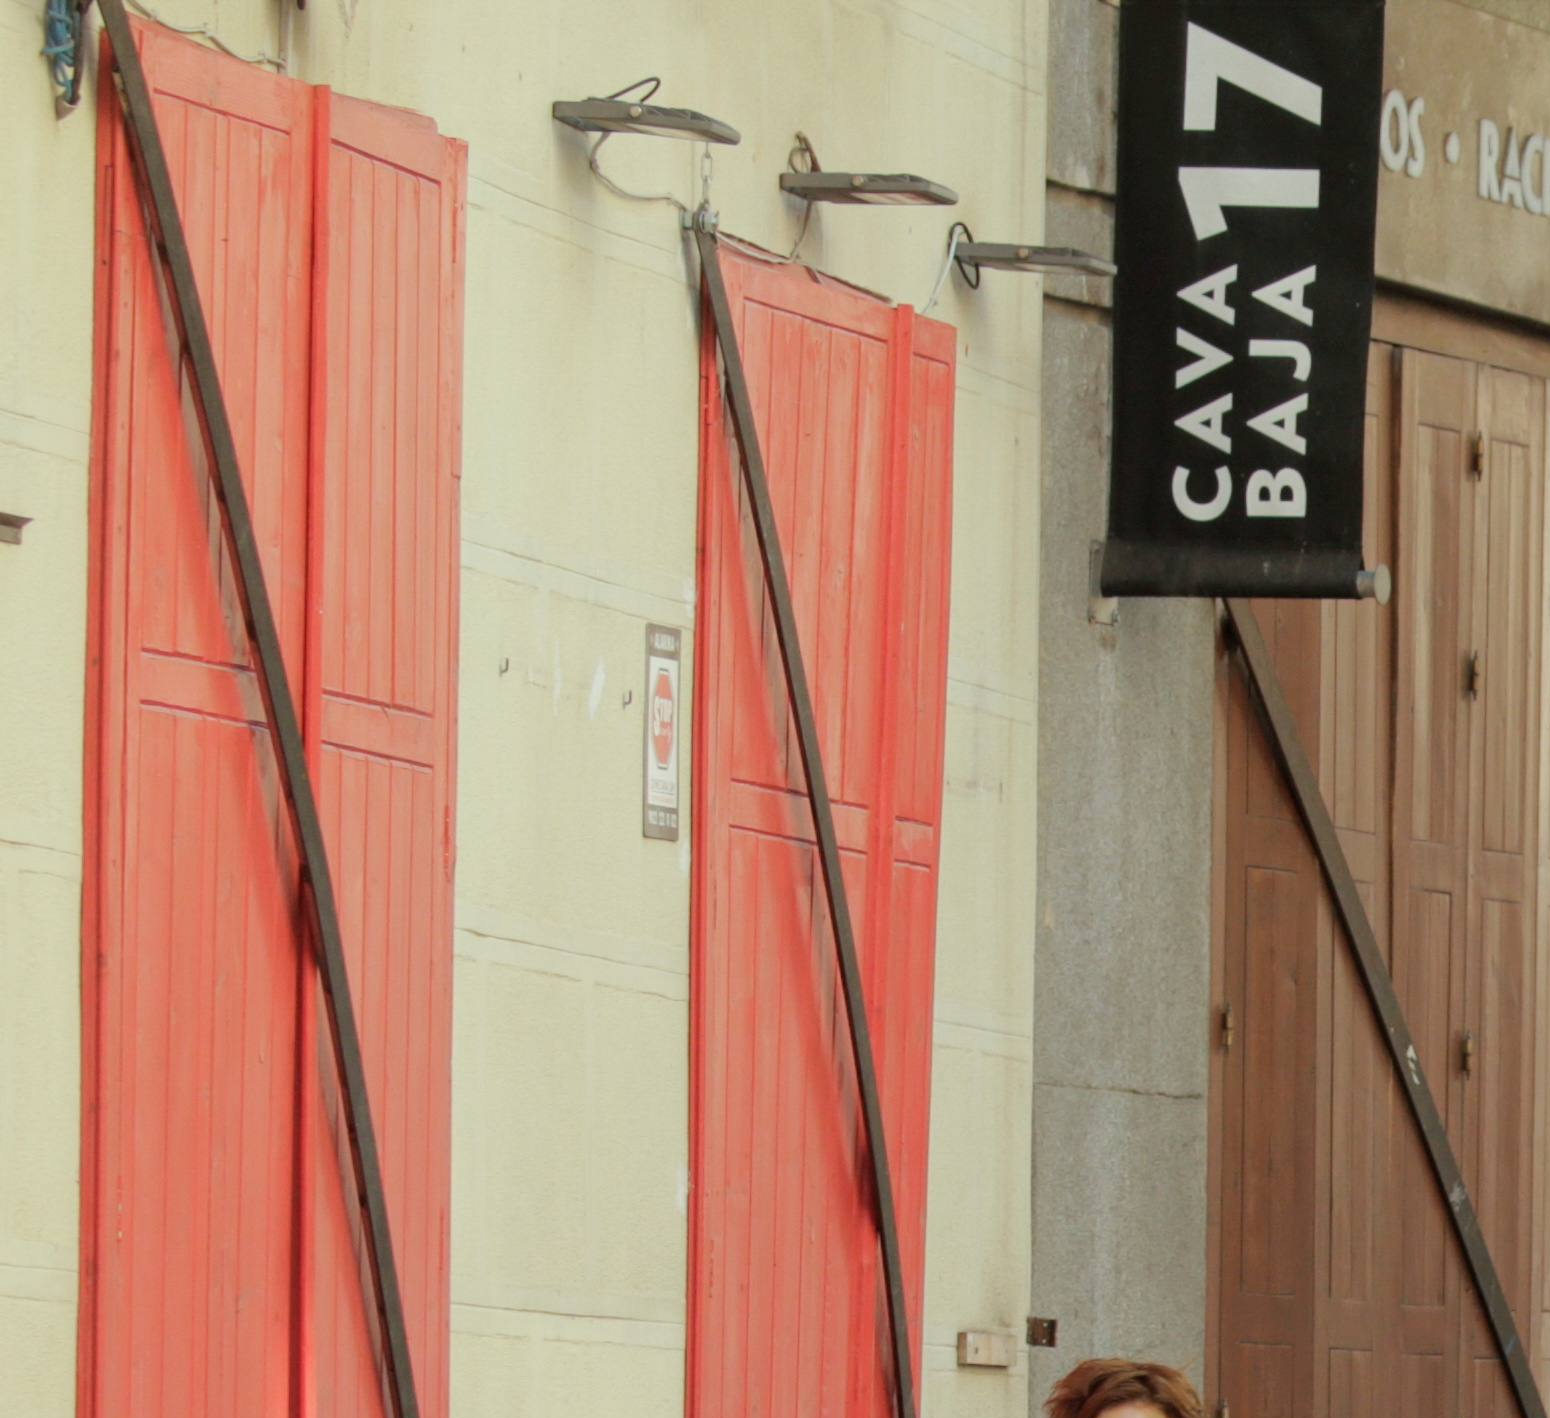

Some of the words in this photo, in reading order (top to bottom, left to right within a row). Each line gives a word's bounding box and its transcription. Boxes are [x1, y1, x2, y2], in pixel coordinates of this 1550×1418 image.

[1178, 22, 1323, 241] 17
[1171, 263, 1238, 522] CAVA
[1245, 264, 1317, 518] BAJA
